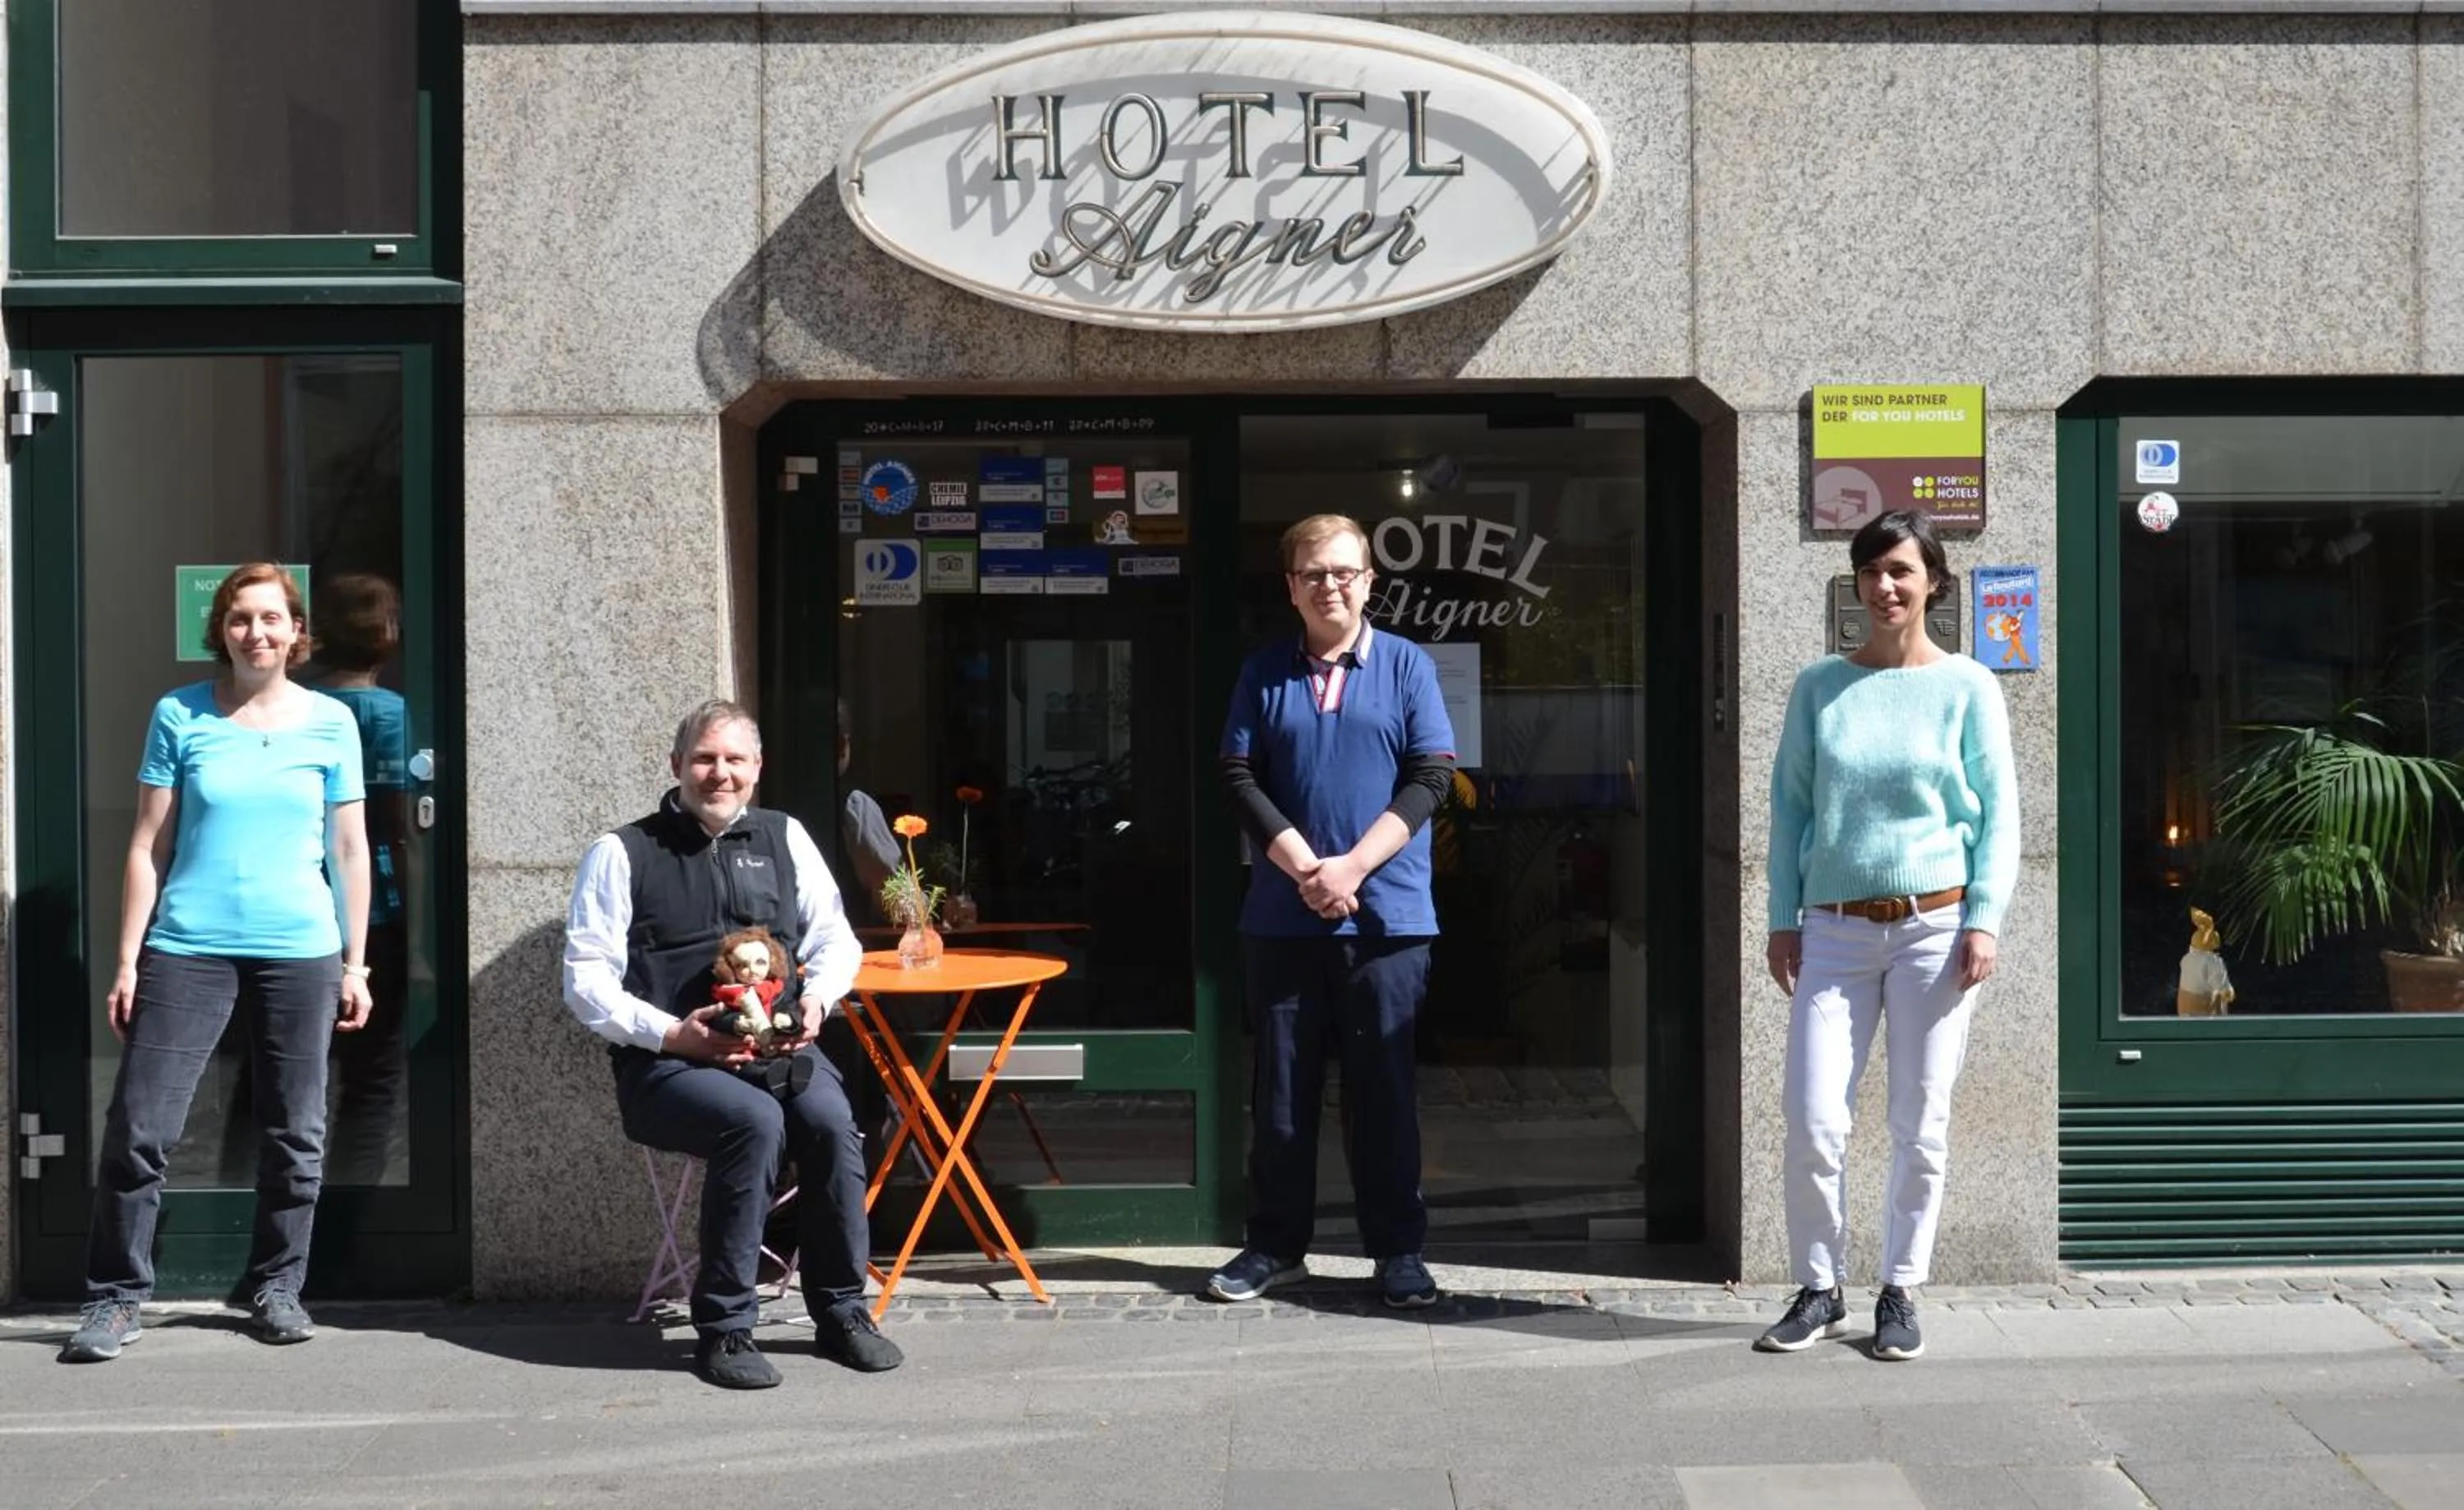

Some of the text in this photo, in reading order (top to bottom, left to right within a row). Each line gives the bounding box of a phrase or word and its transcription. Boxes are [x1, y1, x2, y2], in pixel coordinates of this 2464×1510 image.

[991, 89, 1464, 181] HOTEL
[1030, 181, 1427, 304] Aigner
[1822, 394, 1947, 406] WIR SIND PARTNER
[1822, 410, 1966, 422] DER FOR YOU HOTELS
[930, 483, 967, 495] CHEMIE
[1938, 488, 1979, 499] HOTELS
[931, 495, 967, 506] LEIPZIG
[931, 514, 974, 524] DEHOGA
[1372, 514, 1551, 600] OTEL
[1984, 593, 2033, 608] 2014
